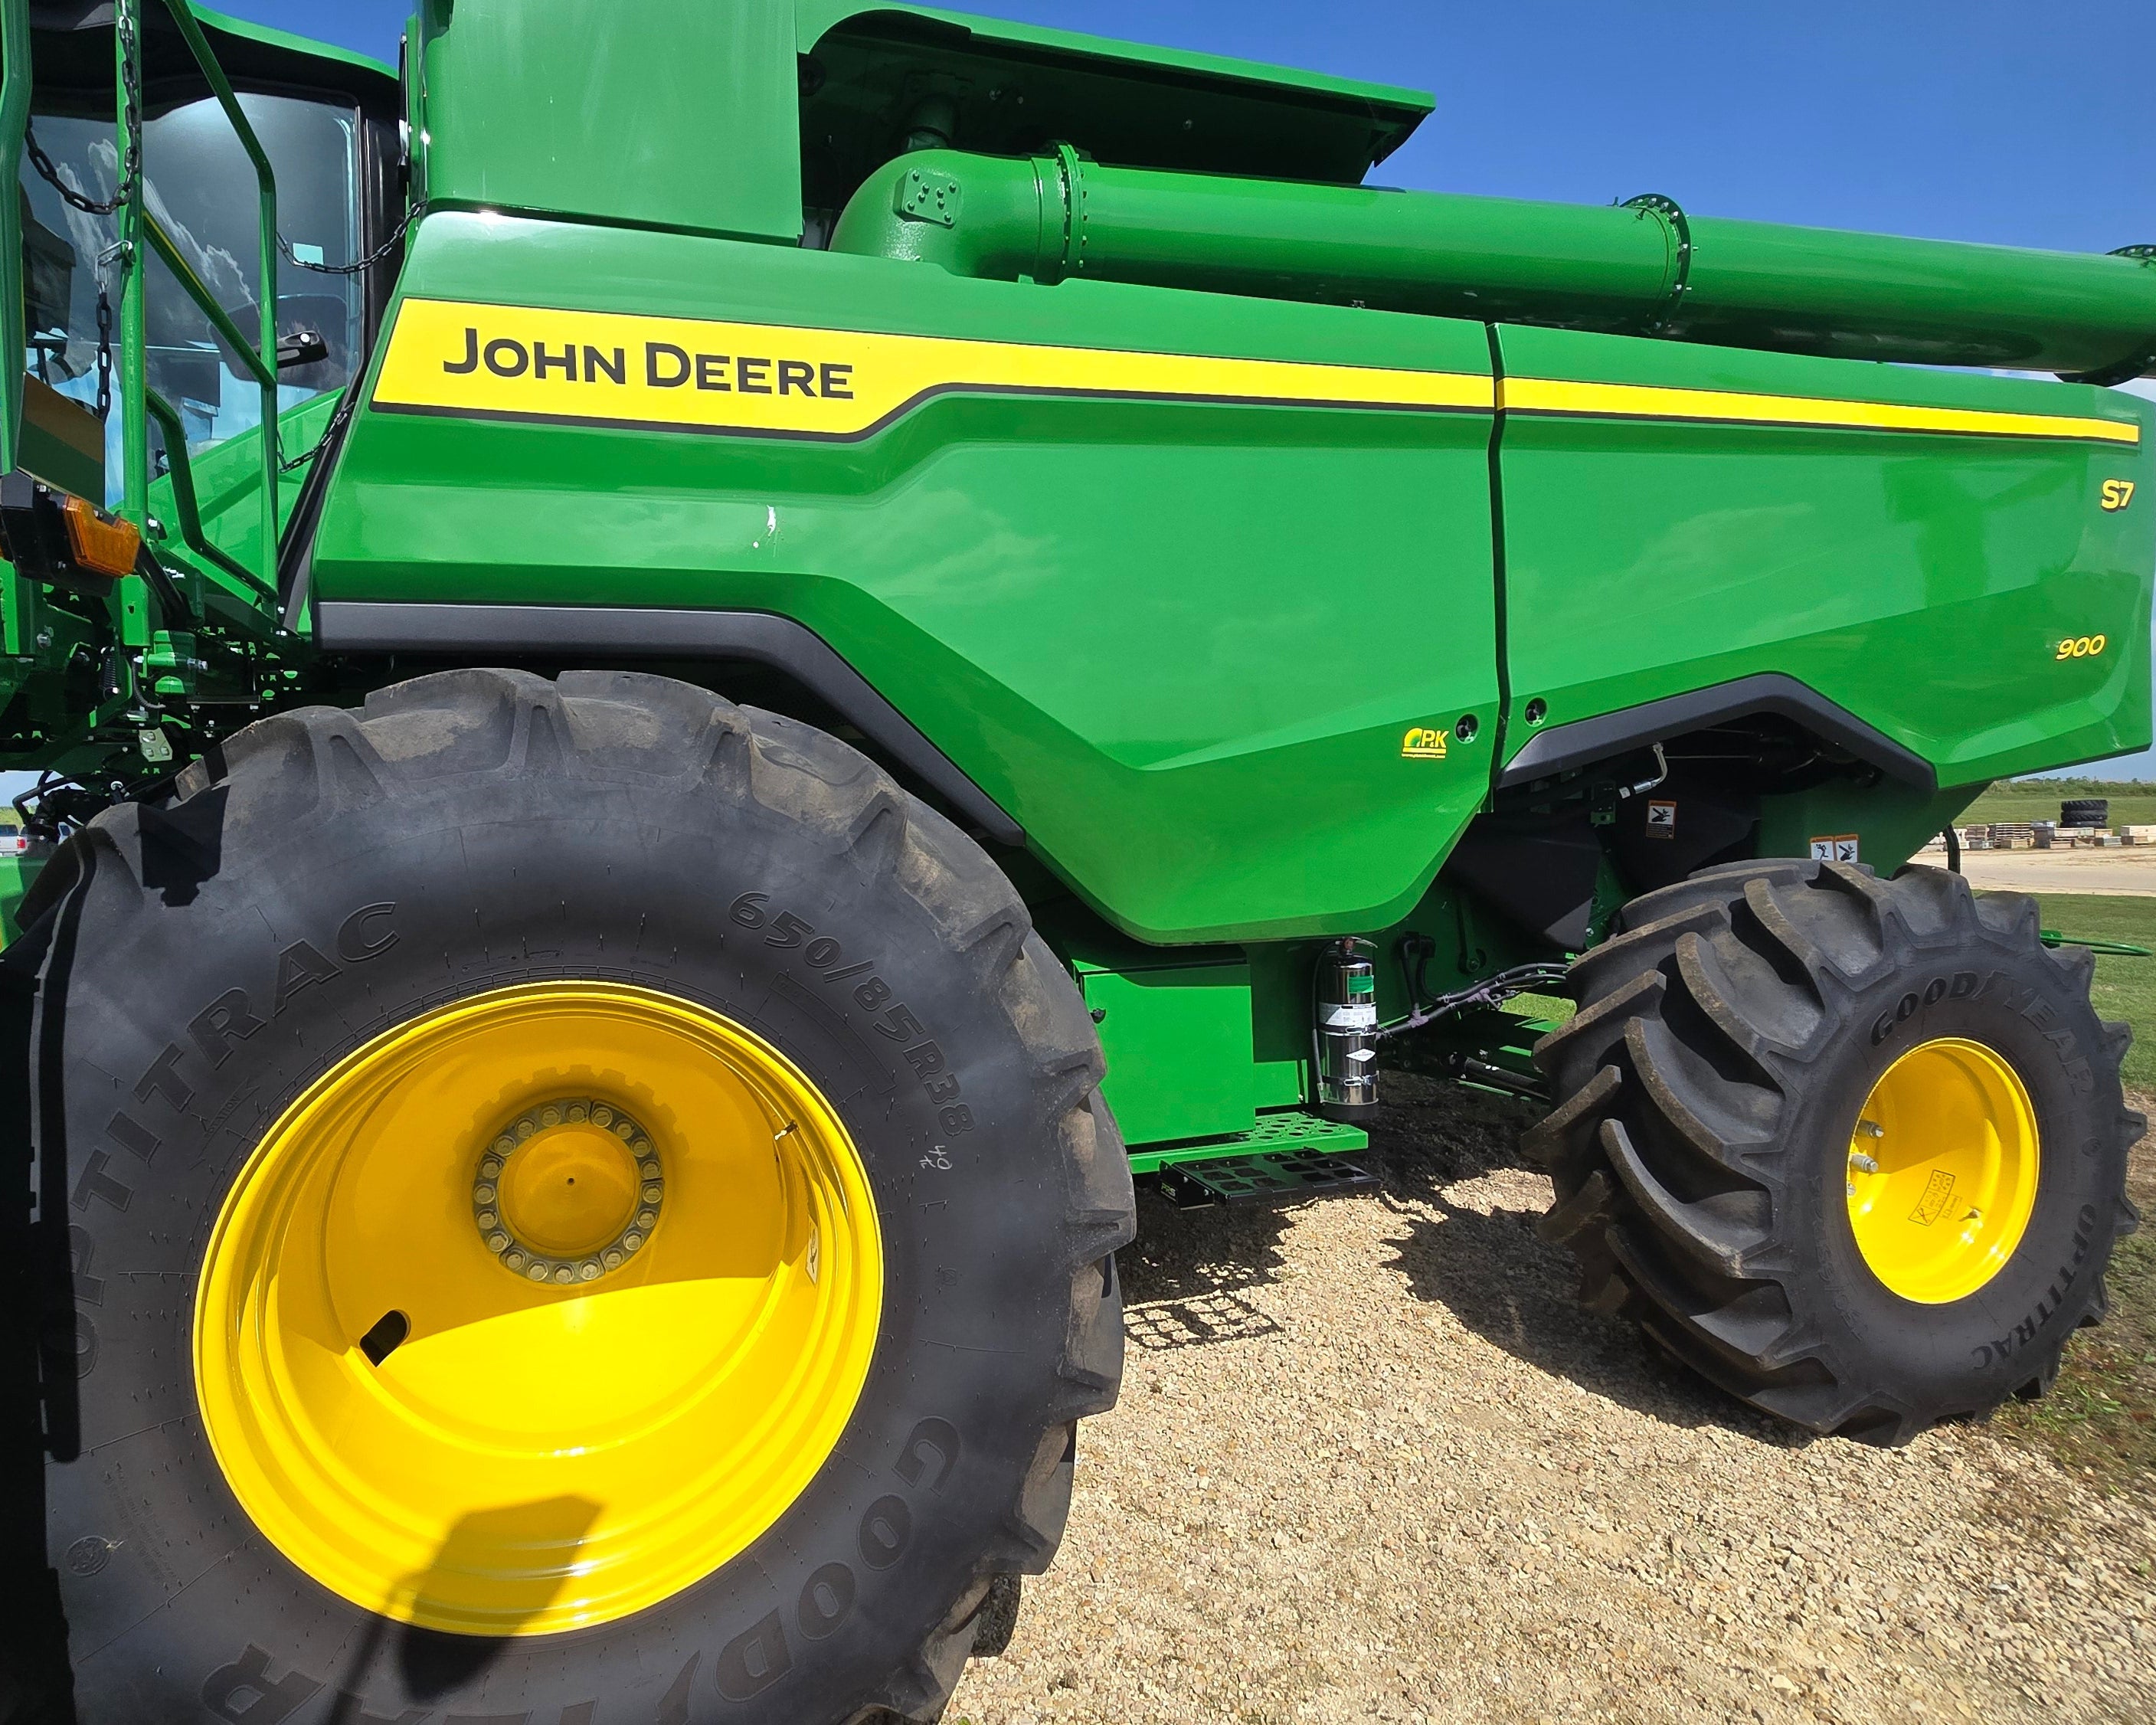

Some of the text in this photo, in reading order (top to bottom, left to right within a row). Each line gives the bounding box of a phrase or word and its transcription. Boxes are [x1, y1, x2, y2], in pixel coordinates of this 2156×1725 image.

[443, 327, 854, 400] JOHN DEERE
[2101, 479, 2135, 510] S7
[2056, 634, 2105, 660] 900
[728, 891, 976, 1137] 650/85R38
[1870, 969, 2094, 1097] GOODYEAR
[40, 901, 401, 1380] OPTITRAC
[1971, 1203, 2097, 1370] OPTITRAC
[199, 1415, 963, 1725] GOODR
